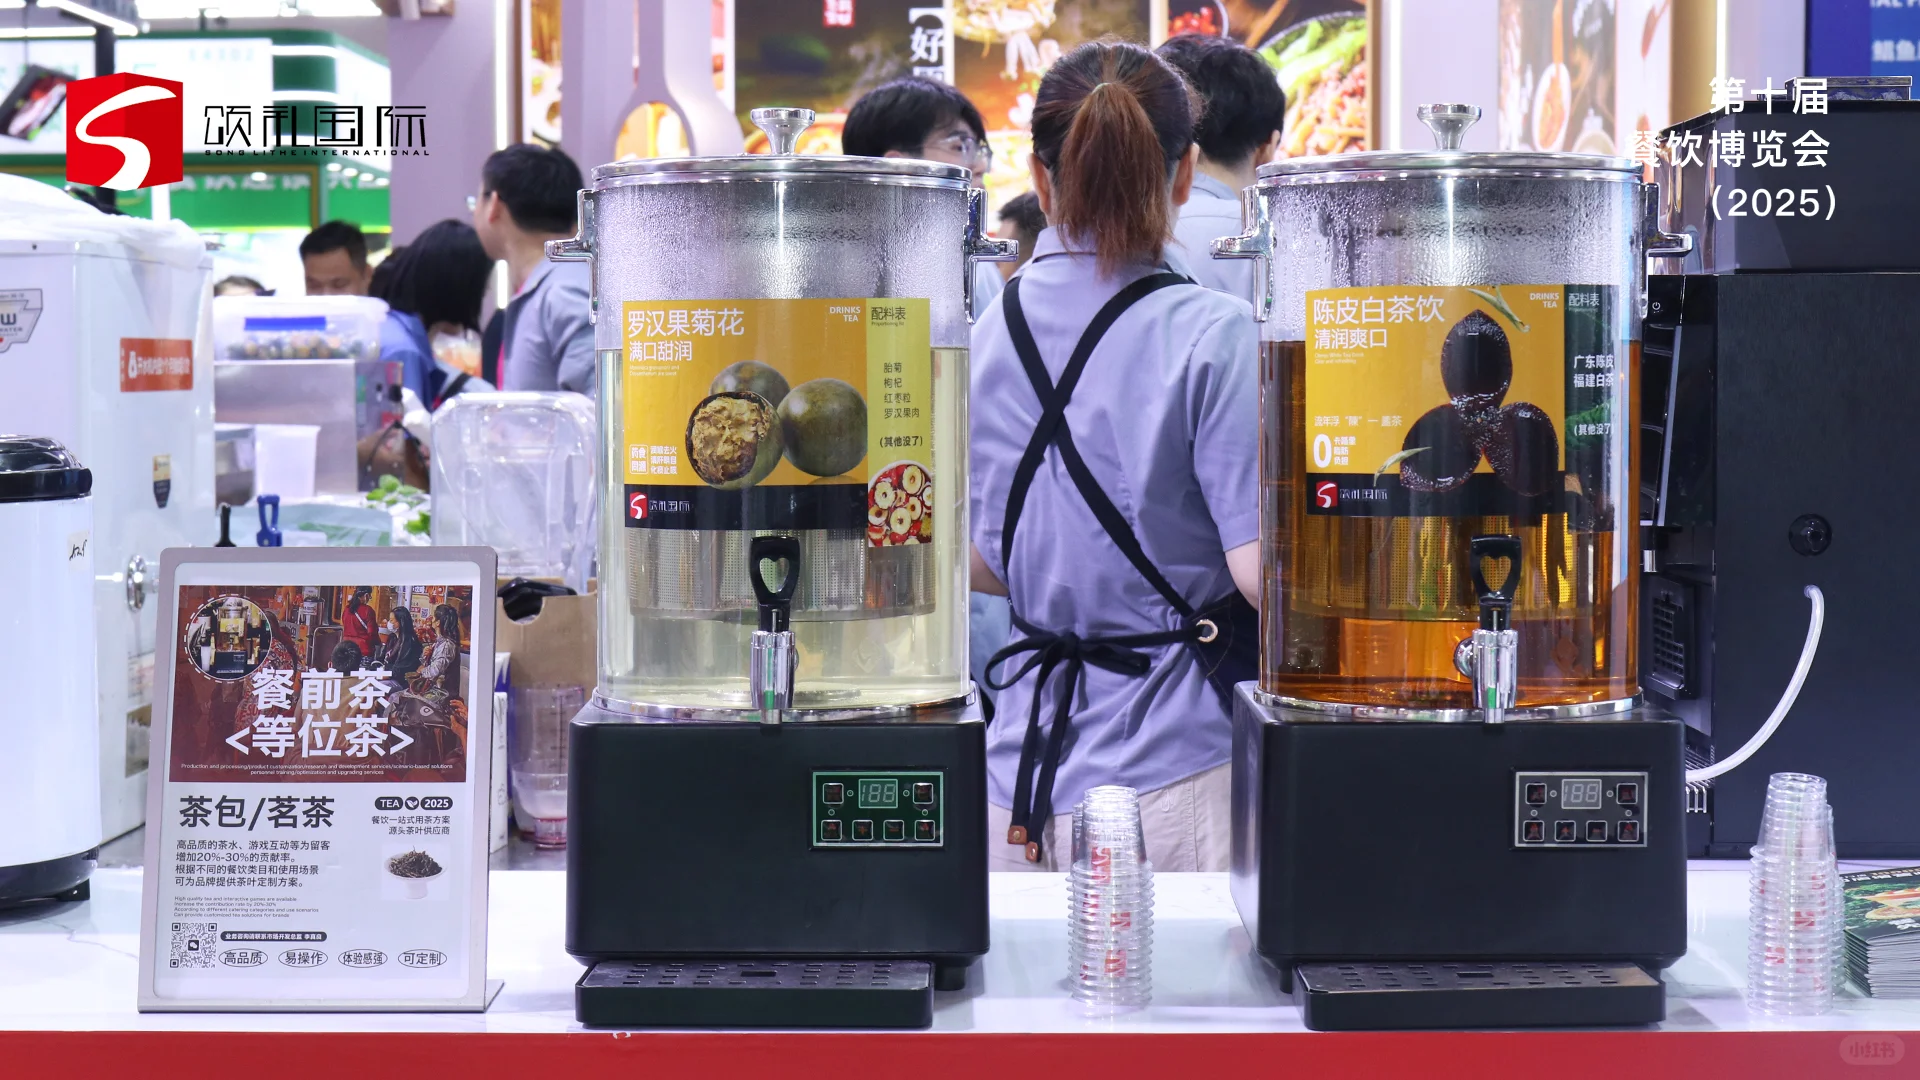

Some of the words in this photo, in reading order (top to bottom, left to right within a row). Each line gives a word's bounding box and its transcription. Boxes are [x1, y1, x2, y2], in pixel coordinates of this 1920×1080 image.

[1530, 292, 1560, 301] DRINKS
[1568, 293, 1600, 307] 配料表
[829, 306, 861, 315] DRINKS
[871, 306, 906, 321] 配料表
[1313, 294, 1445, 325] 陈皮白茶饮
[628, 308, 745, 338] 罗汉果菊花
[1314, 328, 1388, 349] 清润爽口
[629, 340, 693, 362] 满口甜润
[883, 362, 902, 374] 胎菊
[1573, 354, 1614, 369] 广东陈皮
[883, 377, 903, 389] 枸杞
[1573, 373, 1615, 388] 福建白茶
[883, 392, 911, 404] 红枣粒
[884, 407, 920, 419] 罗汉果肉
[879, 435, 923, 448] (其他没了)
[252, 667, 393, 710] 餐前茶
[380, 799, 400, 808] TEA
[424, 799, 449, 808] 2025
[179, 795, 335, 831] 茶包/茗茶
[372, 815, 451, 825] 餐饮一站式用茶方案
[388, 826, 450, 835] 源头茶叶供应商
[175, 864, 319, 875] 根据不同的餐饮类目和使用场景
[223, 951, 263, 965] 高品质
[284, 952, 323, 965] 易操作
[342, 952, 384, 965] 体验感强
[403, 952, 443, 966] 可定制
